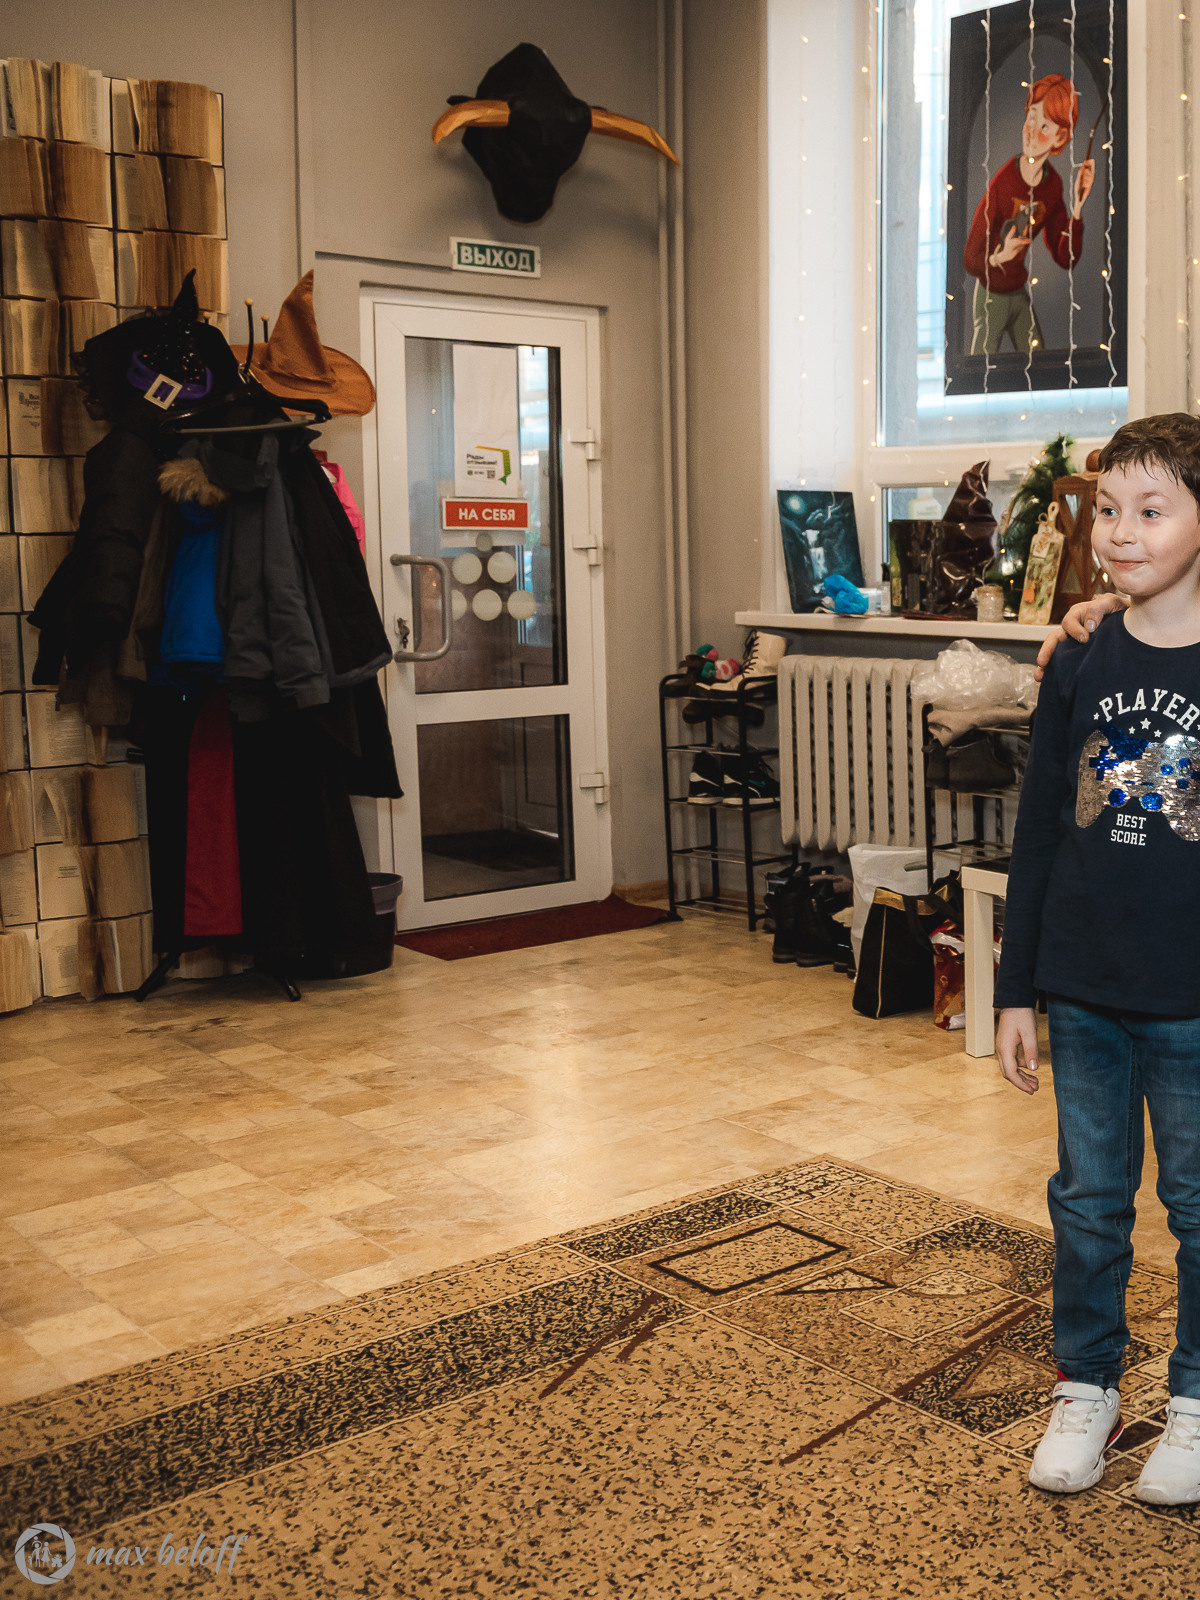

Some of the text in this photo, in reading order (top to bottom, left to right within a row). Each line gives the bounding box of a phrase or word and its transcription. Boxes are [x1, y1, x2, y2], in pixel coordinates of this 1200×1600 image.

[460, 245, 532, 271] ВЫХОД
[458, 508, 516, 521] НА СЕБЯ
[1098, 688, 1200, 732] PLAYER
[1116, 813, 1147, 829] BEST
[1110, 829, 1147, 846] SCORE
